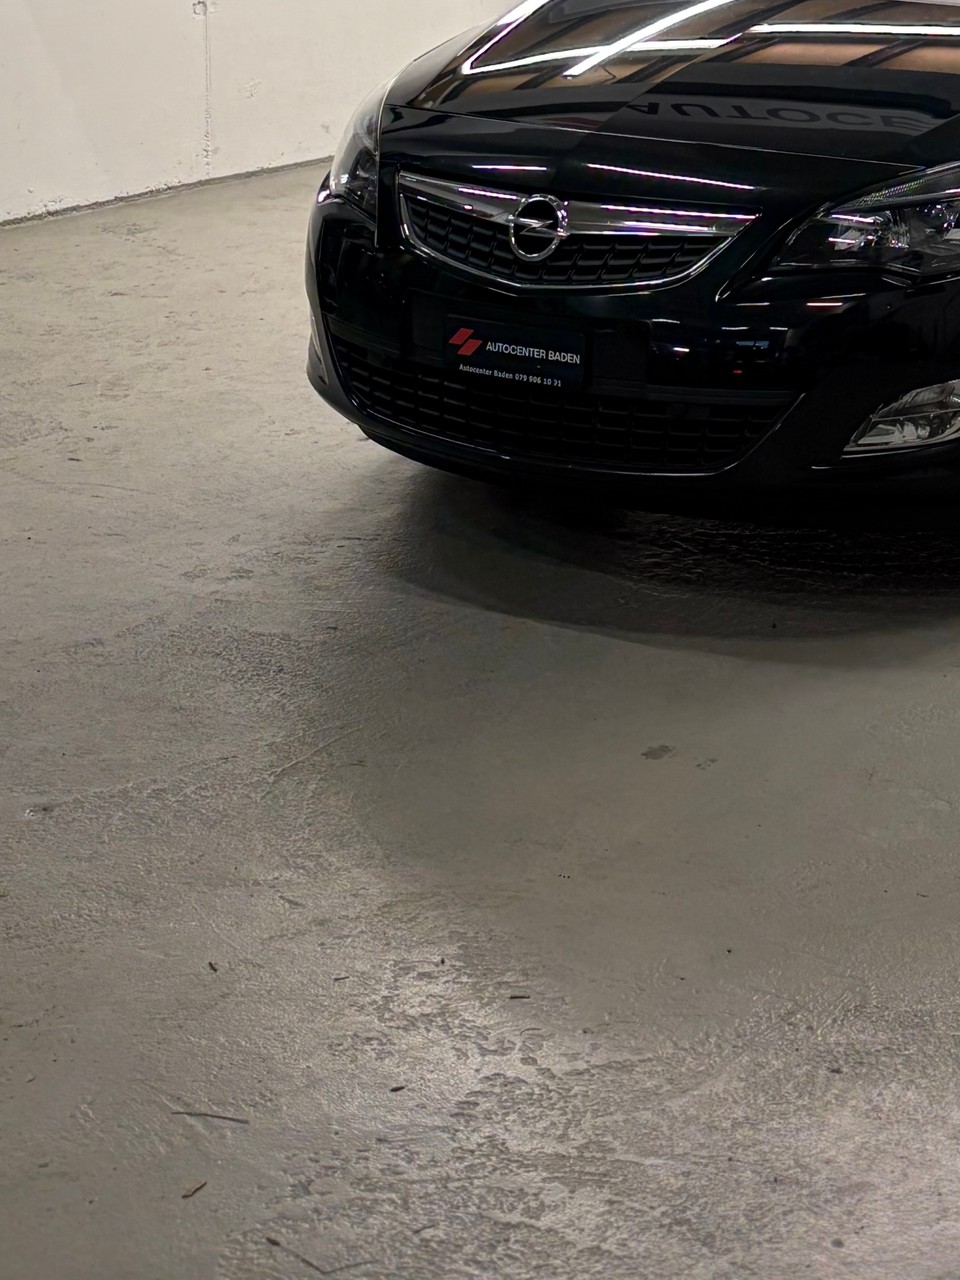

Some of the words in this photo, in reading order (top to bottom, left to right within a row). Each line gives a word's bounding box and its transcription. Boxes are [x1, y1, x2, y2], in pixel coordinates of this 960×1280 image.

[485, 341, 546, 360] AUTOCENTER
[547, 350, 581, 365] BADEN
[458, 363, 492, 376] Autocenter
[493, 369, 514, 380] Baden
[514, 372, 528, 382] 079
[543, 377, 552, 386] 10
